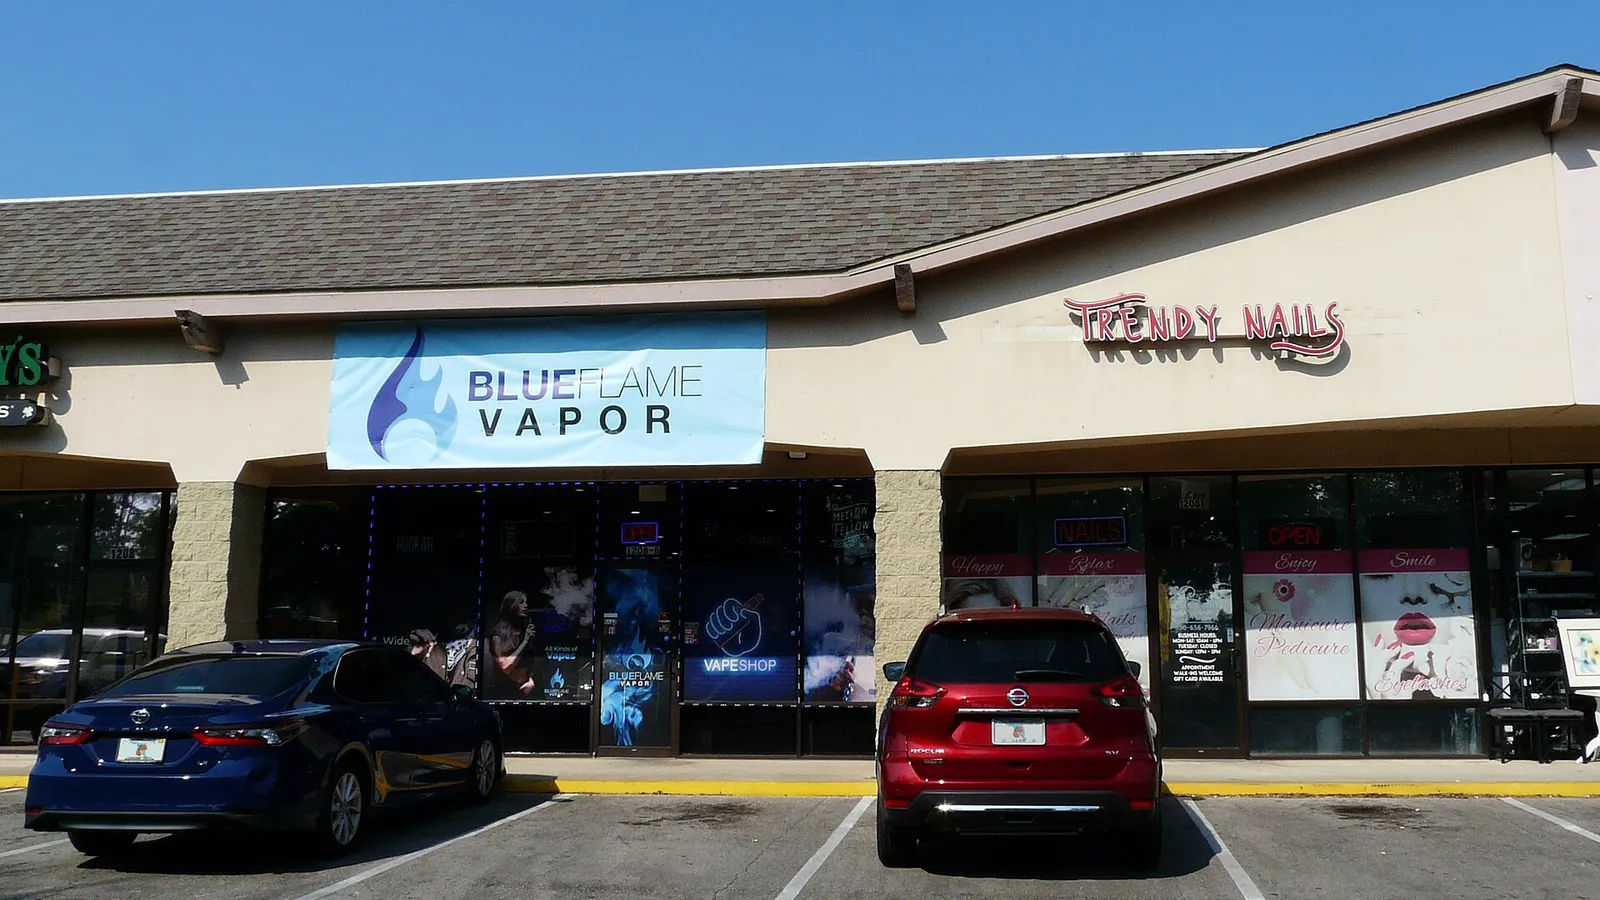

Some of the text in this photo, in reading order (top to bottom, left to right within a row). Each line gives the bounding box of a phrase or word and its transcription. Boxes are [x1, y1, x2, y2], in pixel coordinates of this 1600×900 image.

[1063, 292, 1345, 355] TRENDY NAILS
[468, 365, 703, 402] BLUEFLAME
[479, 404, 671, 437] VAPOR
[623, 524, 656, 541] OPEN
[1059, 520, 1121, 542] NAILS
[1267, 526, 1321, 546] OPEN
[396, 534, 434, 553] HOOKAH
[951, 556, 1005, 575] Happy
[1068, 555, 1116, 572] Relax
[1274, 552, 1318, 572] Enjoy
[1390, 551, 1436, 568] Smile
[1250, 612, 1351, 632] Manicure
[382, 635, 410, 646] Wide
[1254, 634, 1350, 658] Pedicure
[546, 652, 576, 662] Vapes
[608, 671, 664, 681] BLUEFLAME
[1374, 670, 1468, 695] Eyelashes
